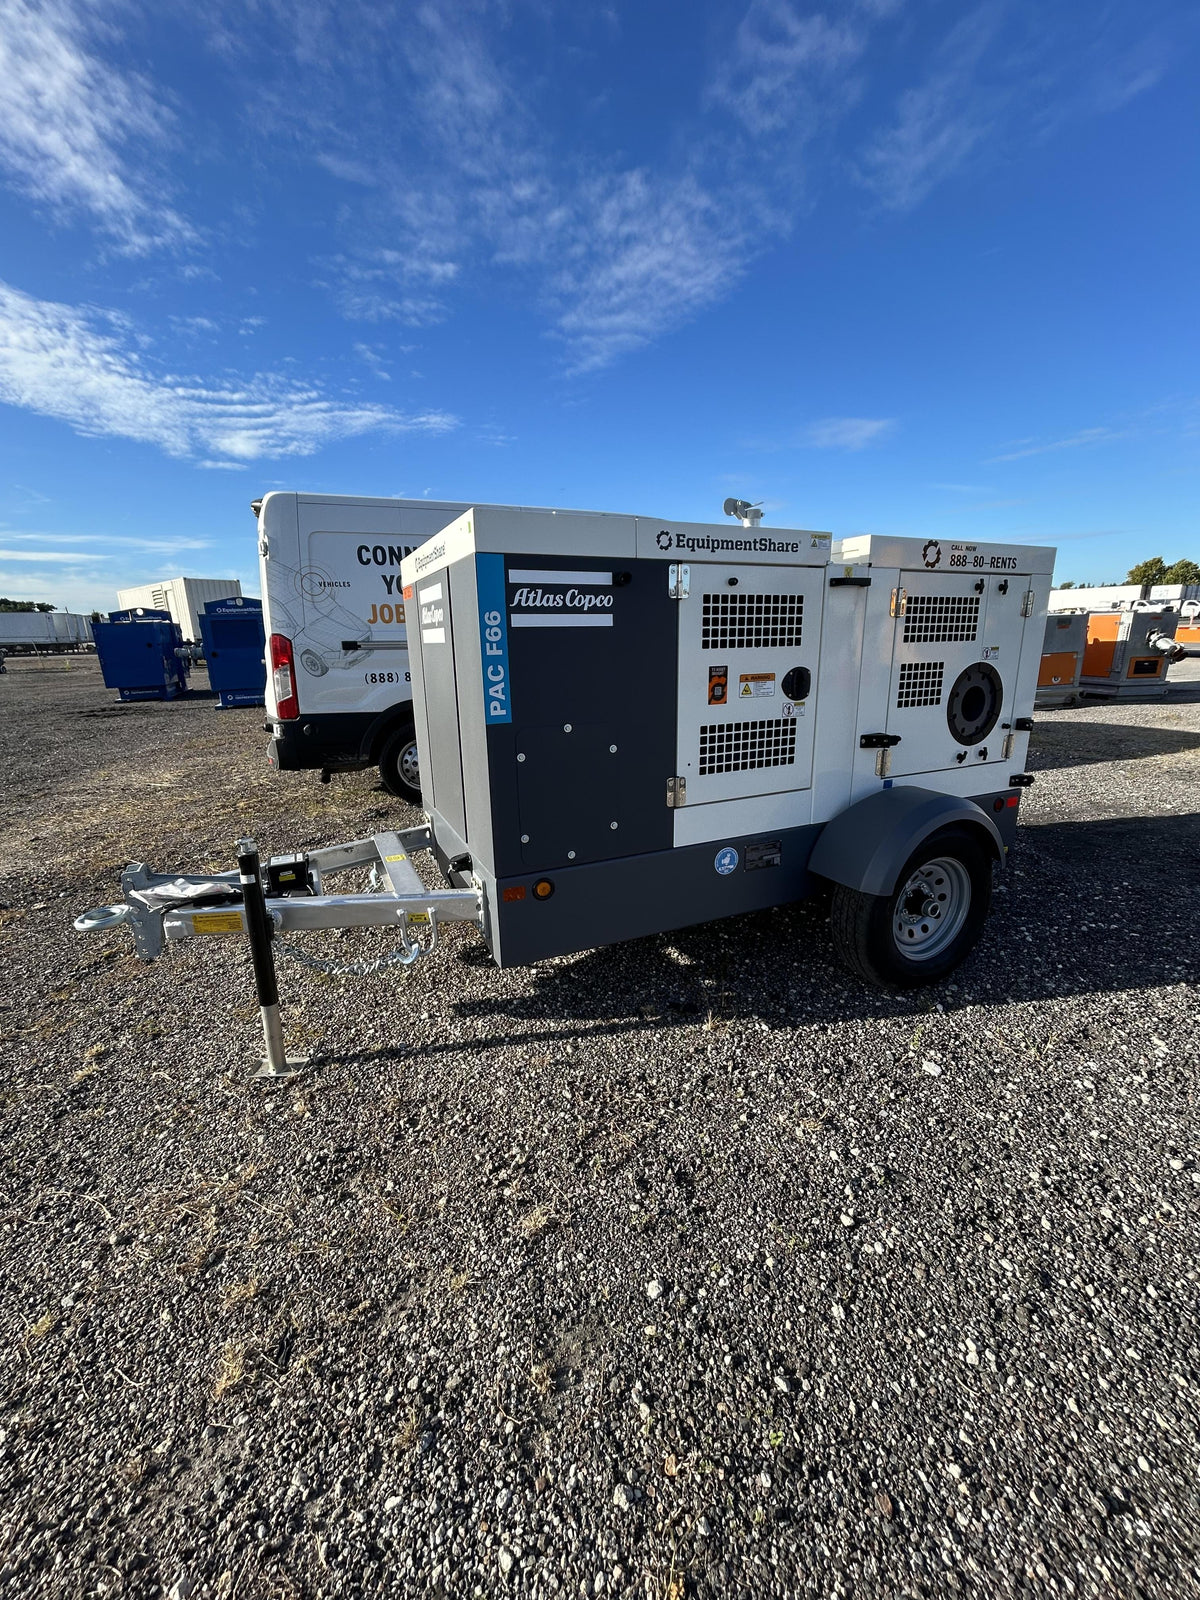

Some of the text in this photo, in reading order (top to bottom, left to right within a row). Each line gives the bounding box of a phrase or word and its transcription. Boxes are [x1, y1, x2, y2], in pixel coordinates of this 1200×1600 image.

[675, 533, 799, 553] EquipmentShare
[509, 588, 614, 611] Atlas Copco
[484, 610, 507, 716] PAC F66
[364, 672, 400, 685] (888)
